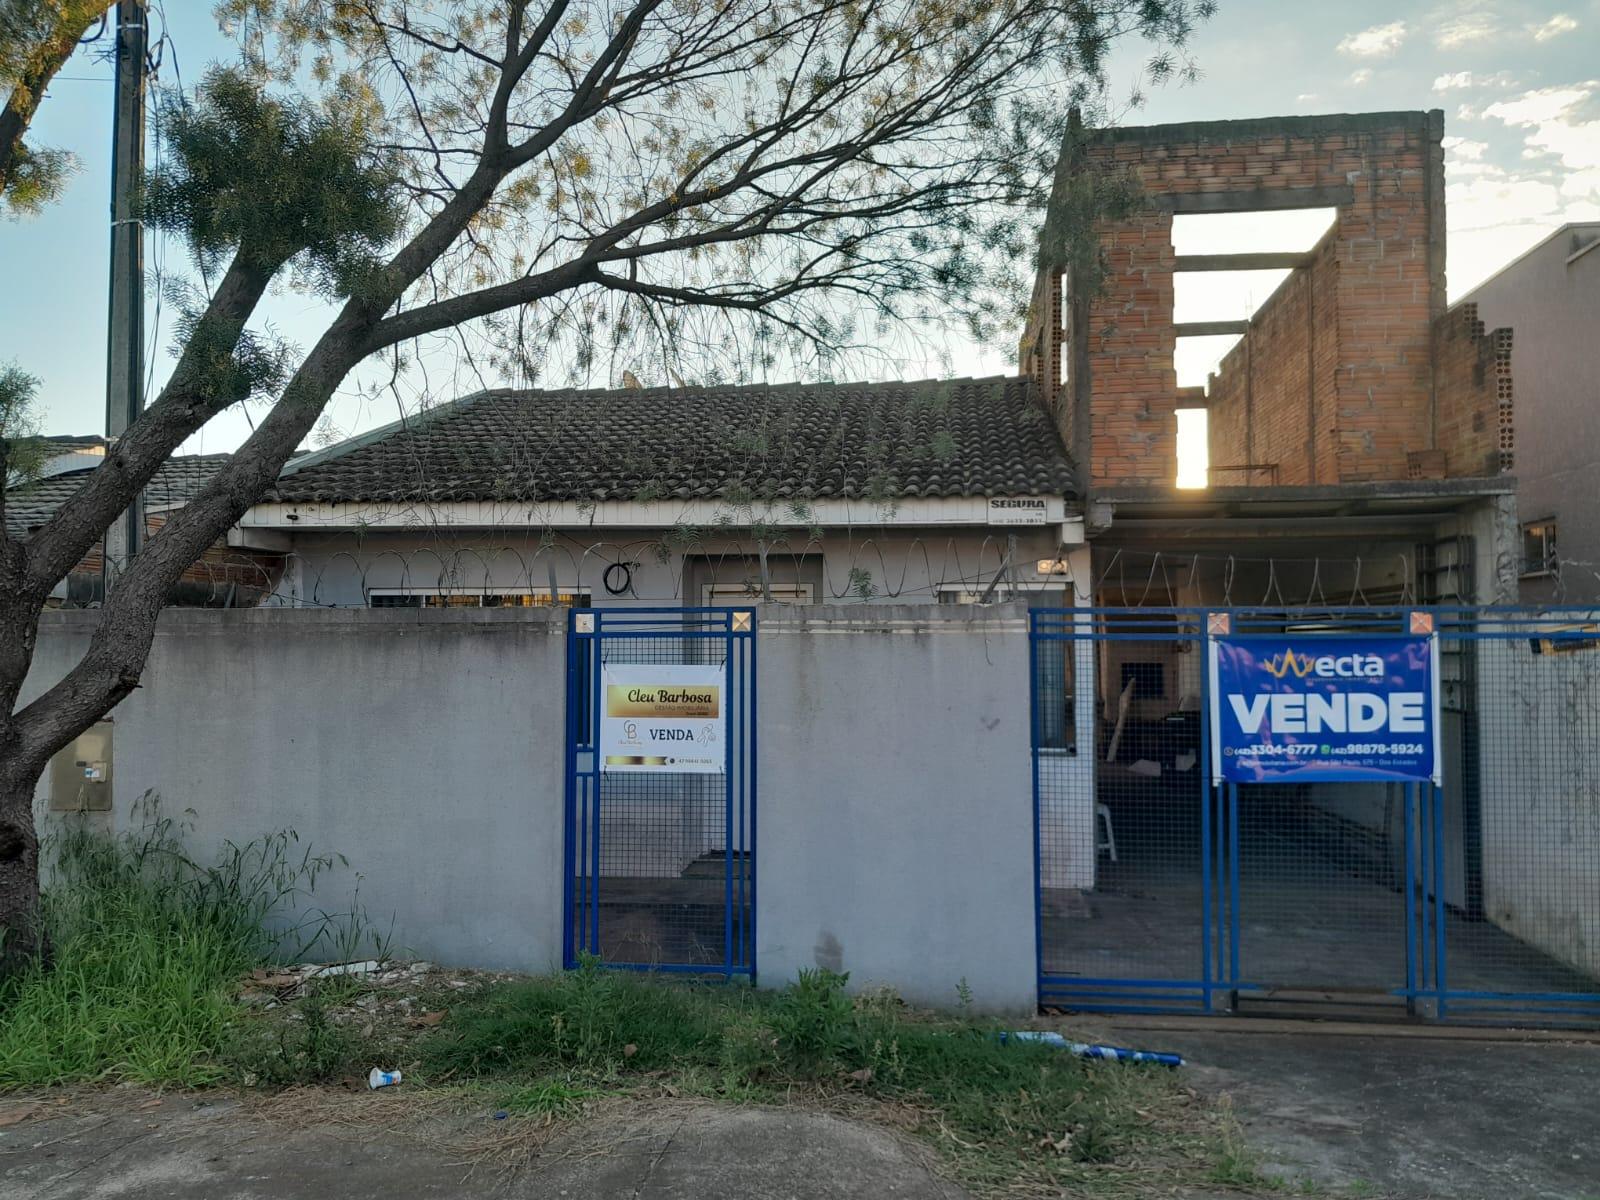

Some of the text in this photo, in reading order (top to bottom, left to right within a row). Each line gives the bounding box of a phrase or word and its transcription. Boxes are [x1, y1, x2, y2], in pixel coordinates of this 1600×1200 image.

[991, 500, 1044, 508] SEGURA
[628, 689, 712, 703] Cleu Barbosa
[1228, 692, 1425, 734] VENDE
[649, 729, 694, 740] VENDA
